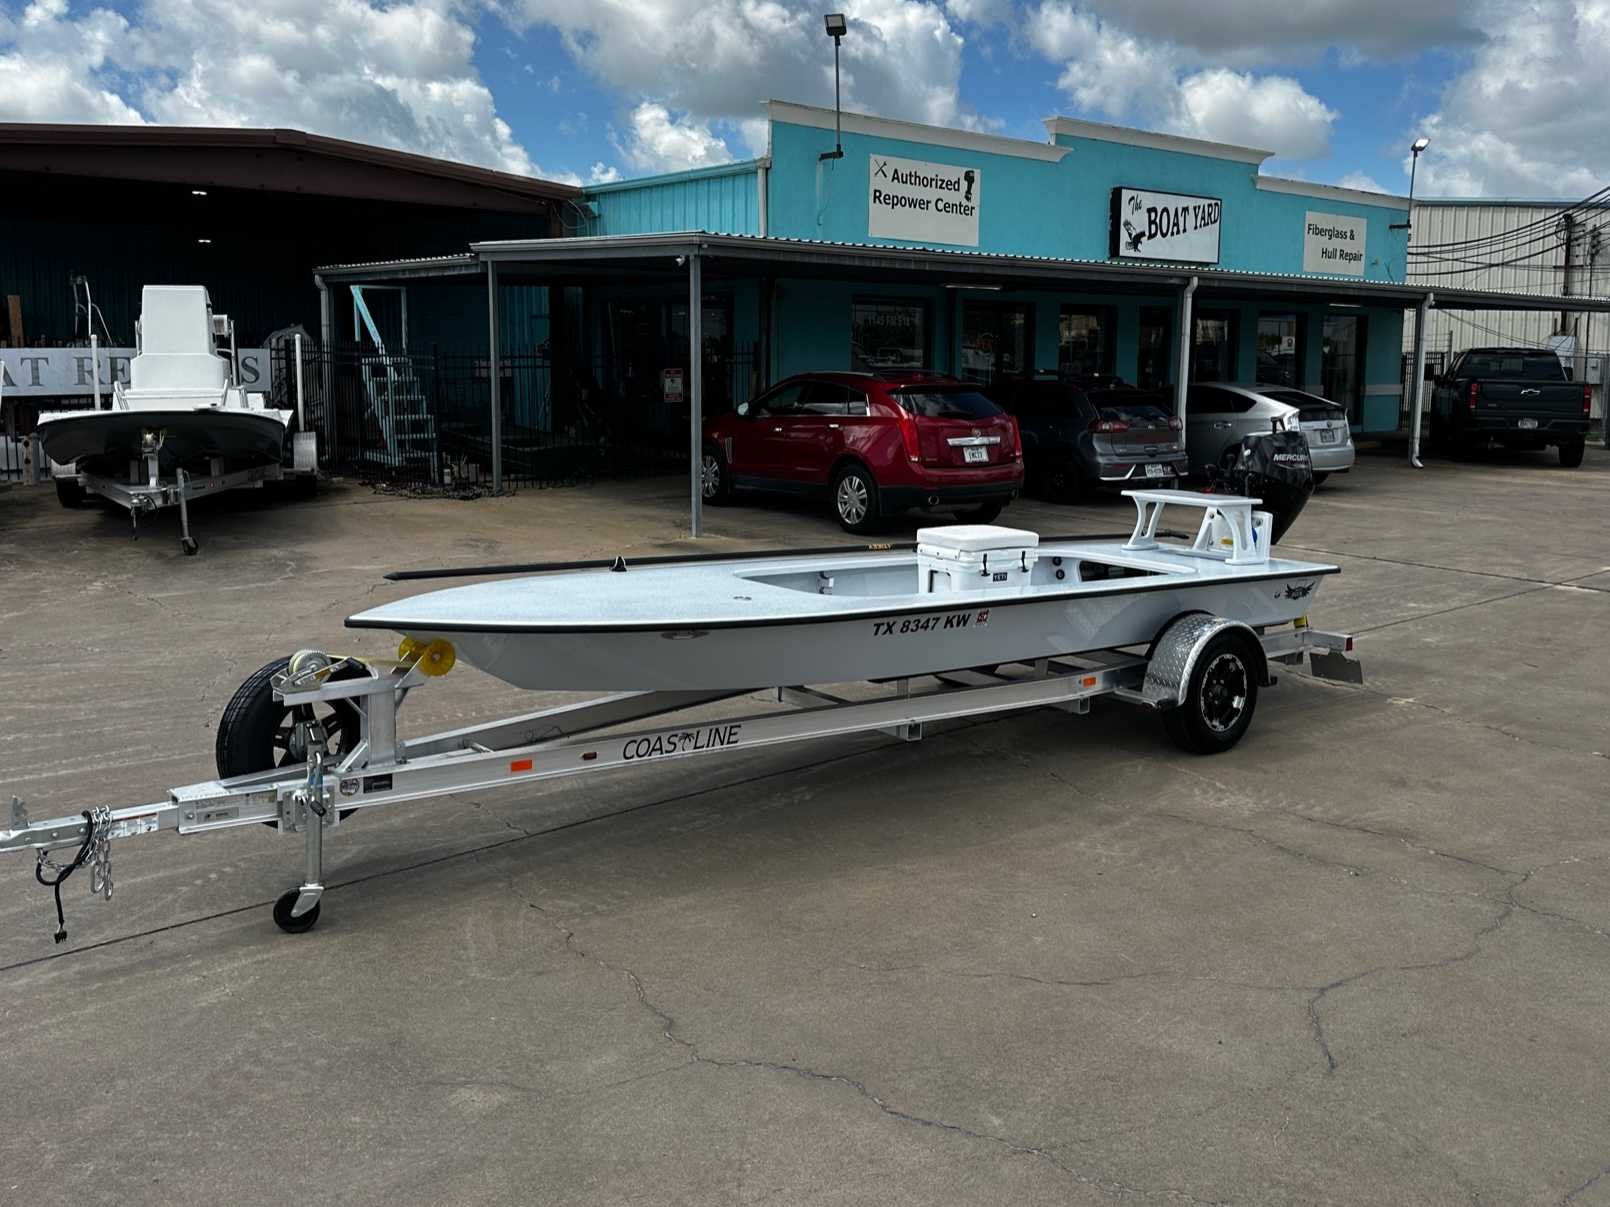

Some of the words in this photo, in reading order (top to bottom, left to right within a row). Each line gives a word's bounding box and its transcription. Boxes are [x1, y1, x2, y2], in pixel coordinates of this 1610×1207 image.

[891, 168, 960, 192] Authorized
[873, 189, 931, 211] Repower
[935, 198, 975, 216] Center
[1128, 194, 1142, 216] The
[1146, 206, 1189, 240] BOAT
[1193, 202, 1219, 230] YARD
[1307, 223, 1347, 240] Fiberglass
[1350, 229, 1355, 241] &
[1321, 247, 1337, 260] Hull
[1340, 249, 1363, 263] Repair
[874, 621, 896, 636] TX
[900, 616, 941, 634] 8347
[944, 613, 971, 629] KW
